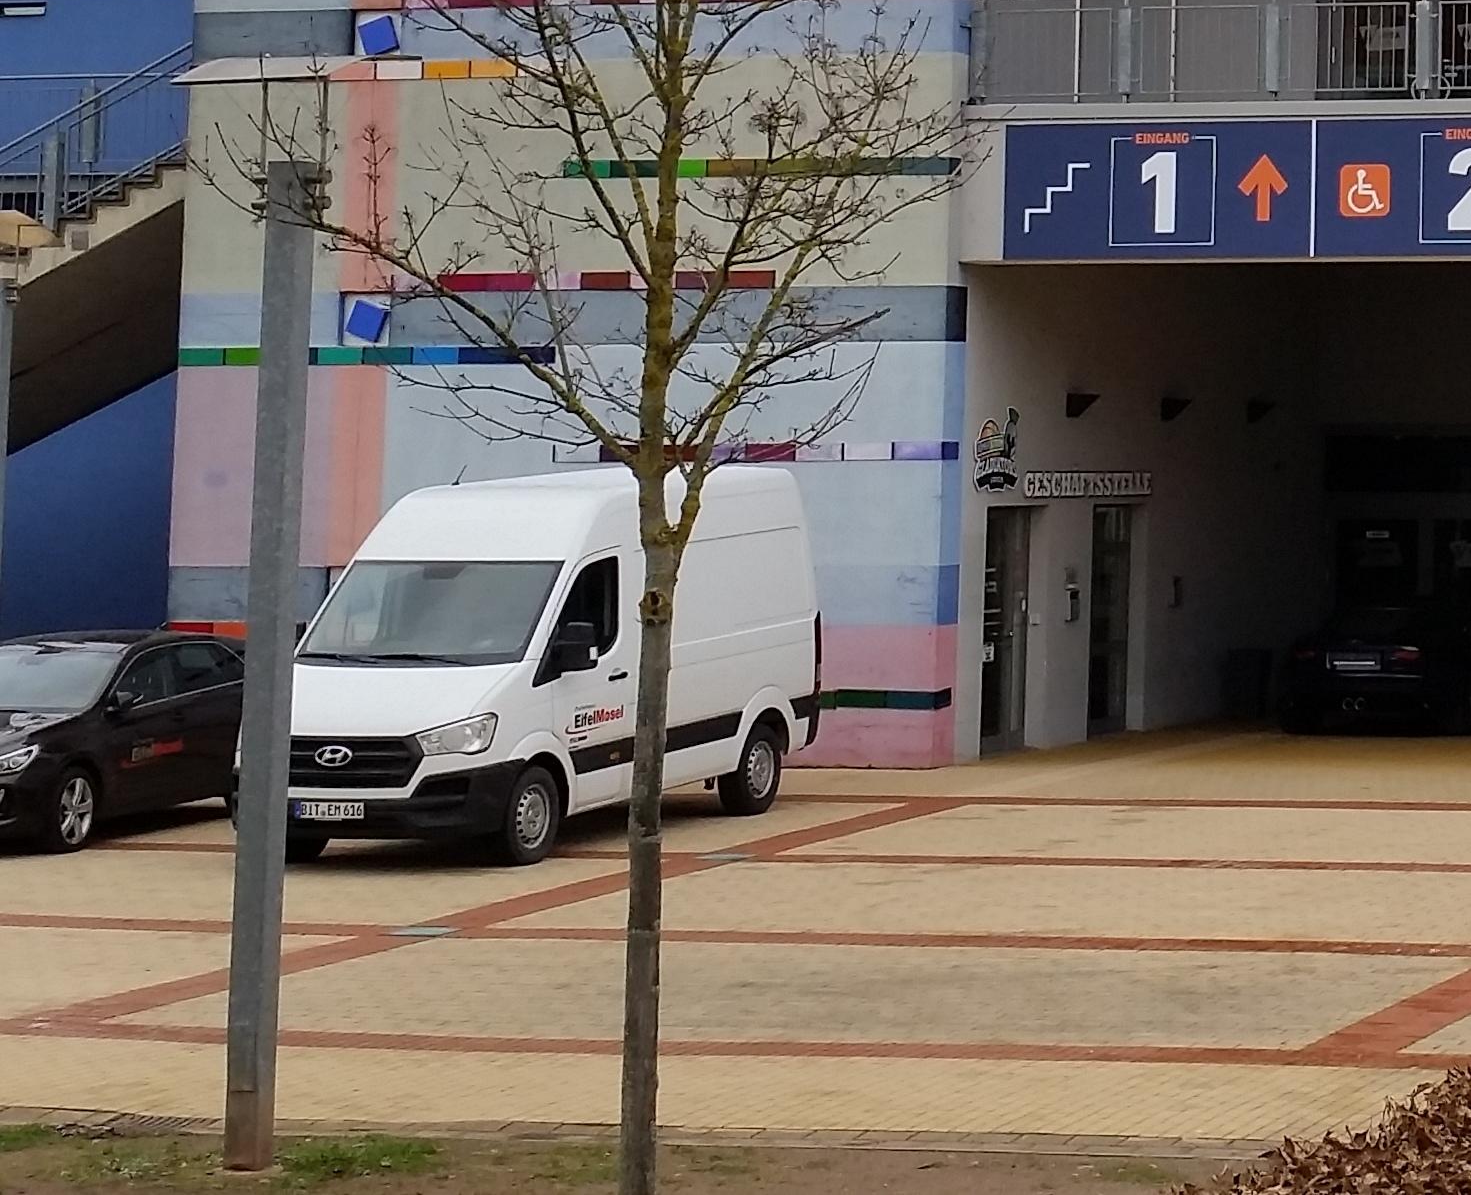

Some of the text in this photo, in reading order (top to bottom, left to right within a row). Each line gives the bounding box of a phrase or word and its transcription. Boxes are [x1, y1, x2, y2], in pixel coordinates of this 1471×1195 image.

[1135, 132, 1190, 145] EINGANG
[1141, 151, 1177, 234] 1
[574, 704, 625, 729] EifelMosel
[301, 804, 320, 816] BIT
[343, 804, 362, 816] 616
